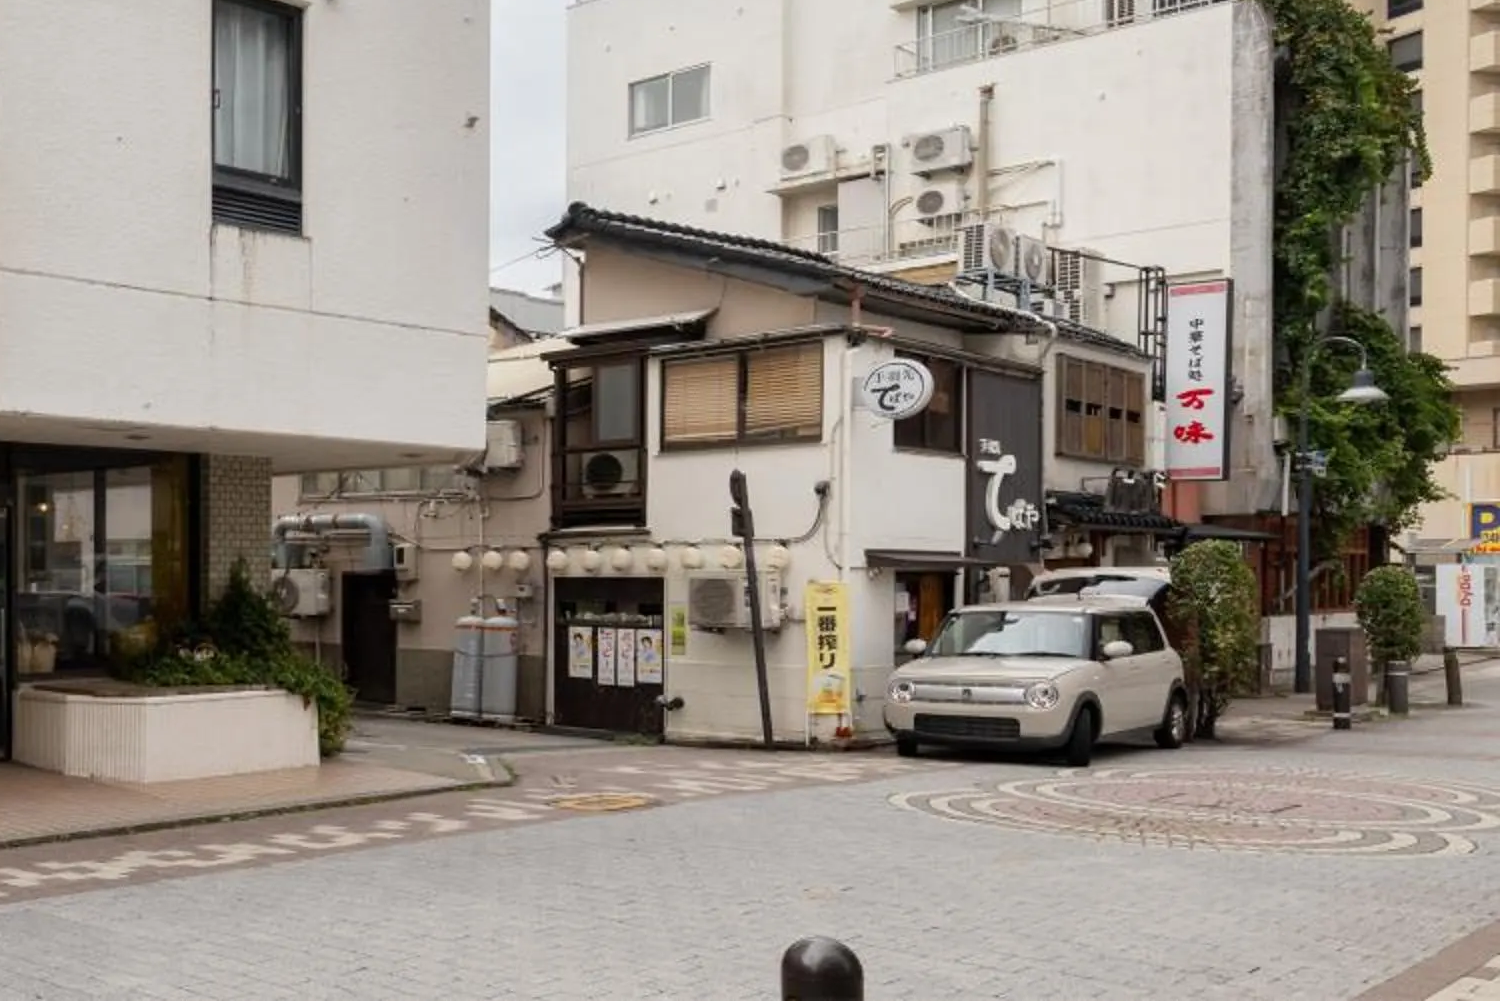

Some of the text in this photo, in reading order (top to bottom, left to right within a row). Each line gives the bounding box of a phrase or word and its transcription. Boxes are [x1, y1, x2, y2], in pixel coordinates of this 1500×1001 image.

[1188, 318, 1205, 381] 中華そば処
[1174, 388, 1214, 444] 万味
[976, 454, 1039, 530] てばや
[817, 605, 837, 669] 一番搾り
